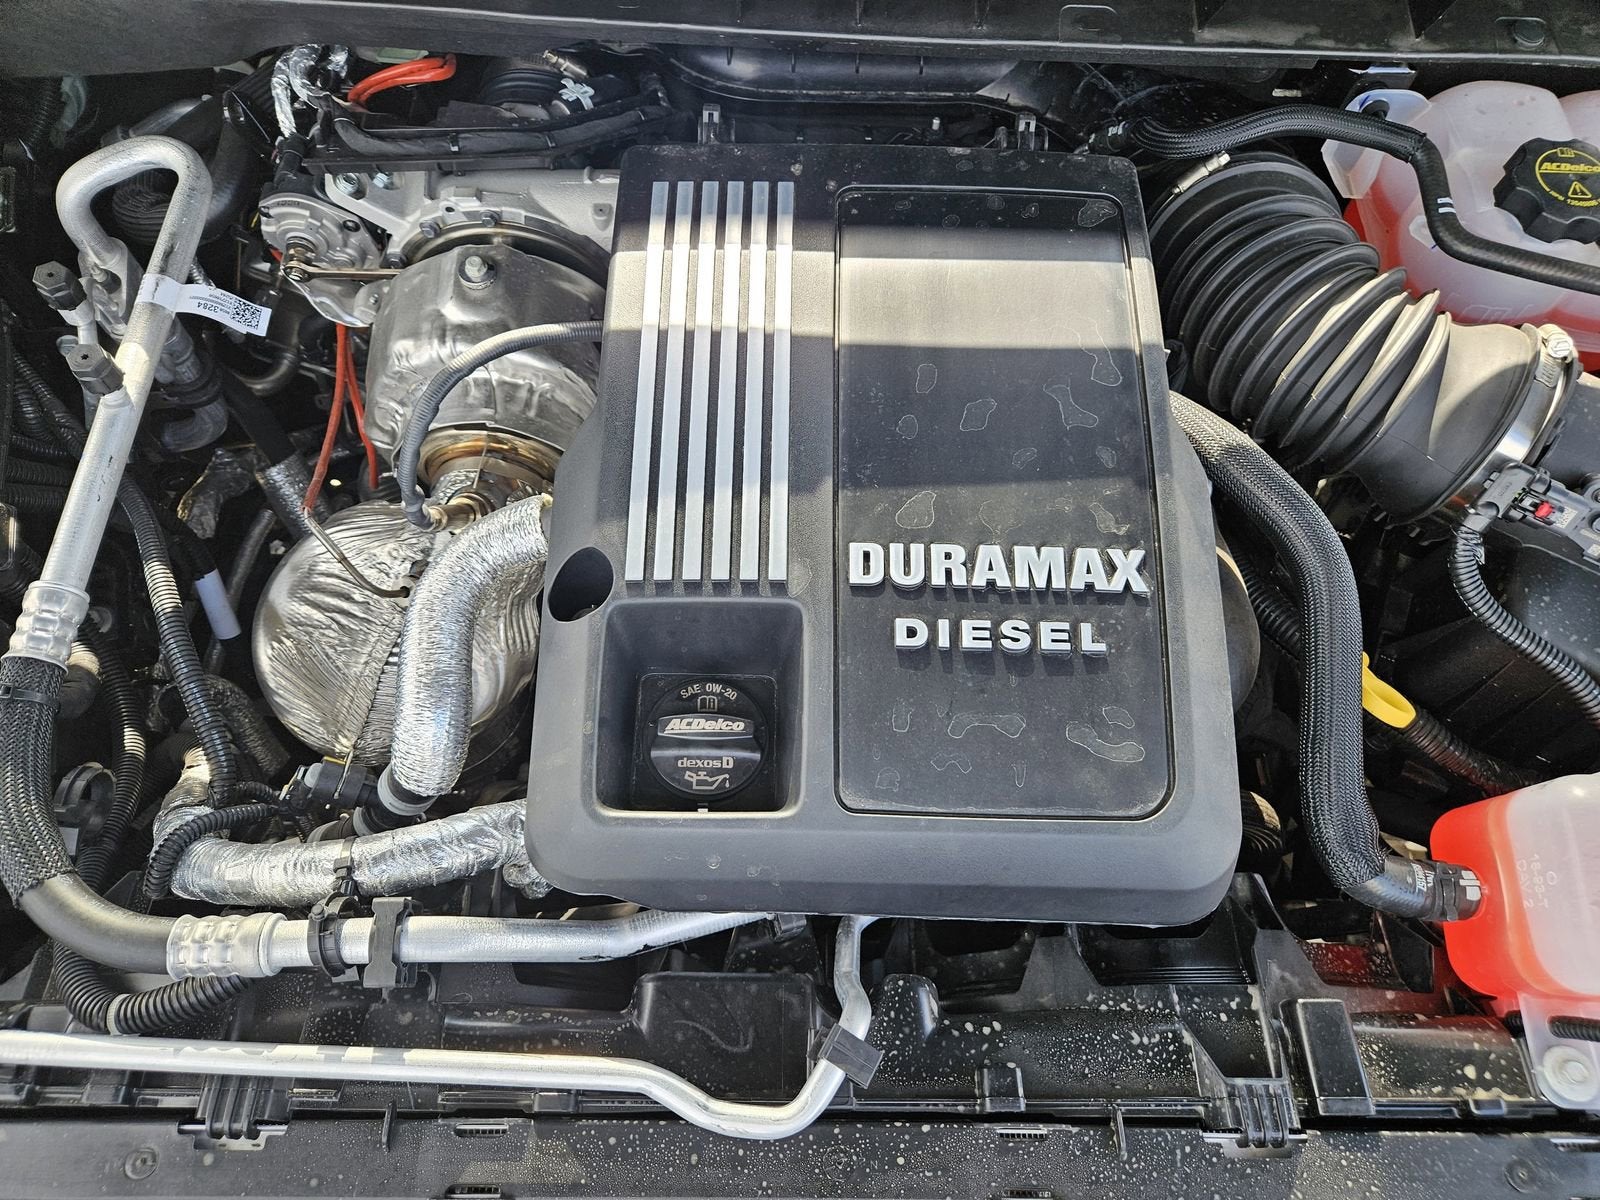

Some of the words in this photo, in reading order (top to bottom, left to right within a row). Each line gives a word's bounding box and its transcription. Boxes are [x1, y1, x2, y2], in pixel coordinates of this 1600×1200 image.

[1540, 162, 1600, 172] ACDelco
[197, 301, 219, 313] 3284
[849, 542, 1150, 593] DURAMAX
[894, 617, 1108, 653] DIESEL
[680, 684, 701, 699] SAE
[706, 683, 738, 700] 0W-20
[664, 718, 746, 732] ACDelco
